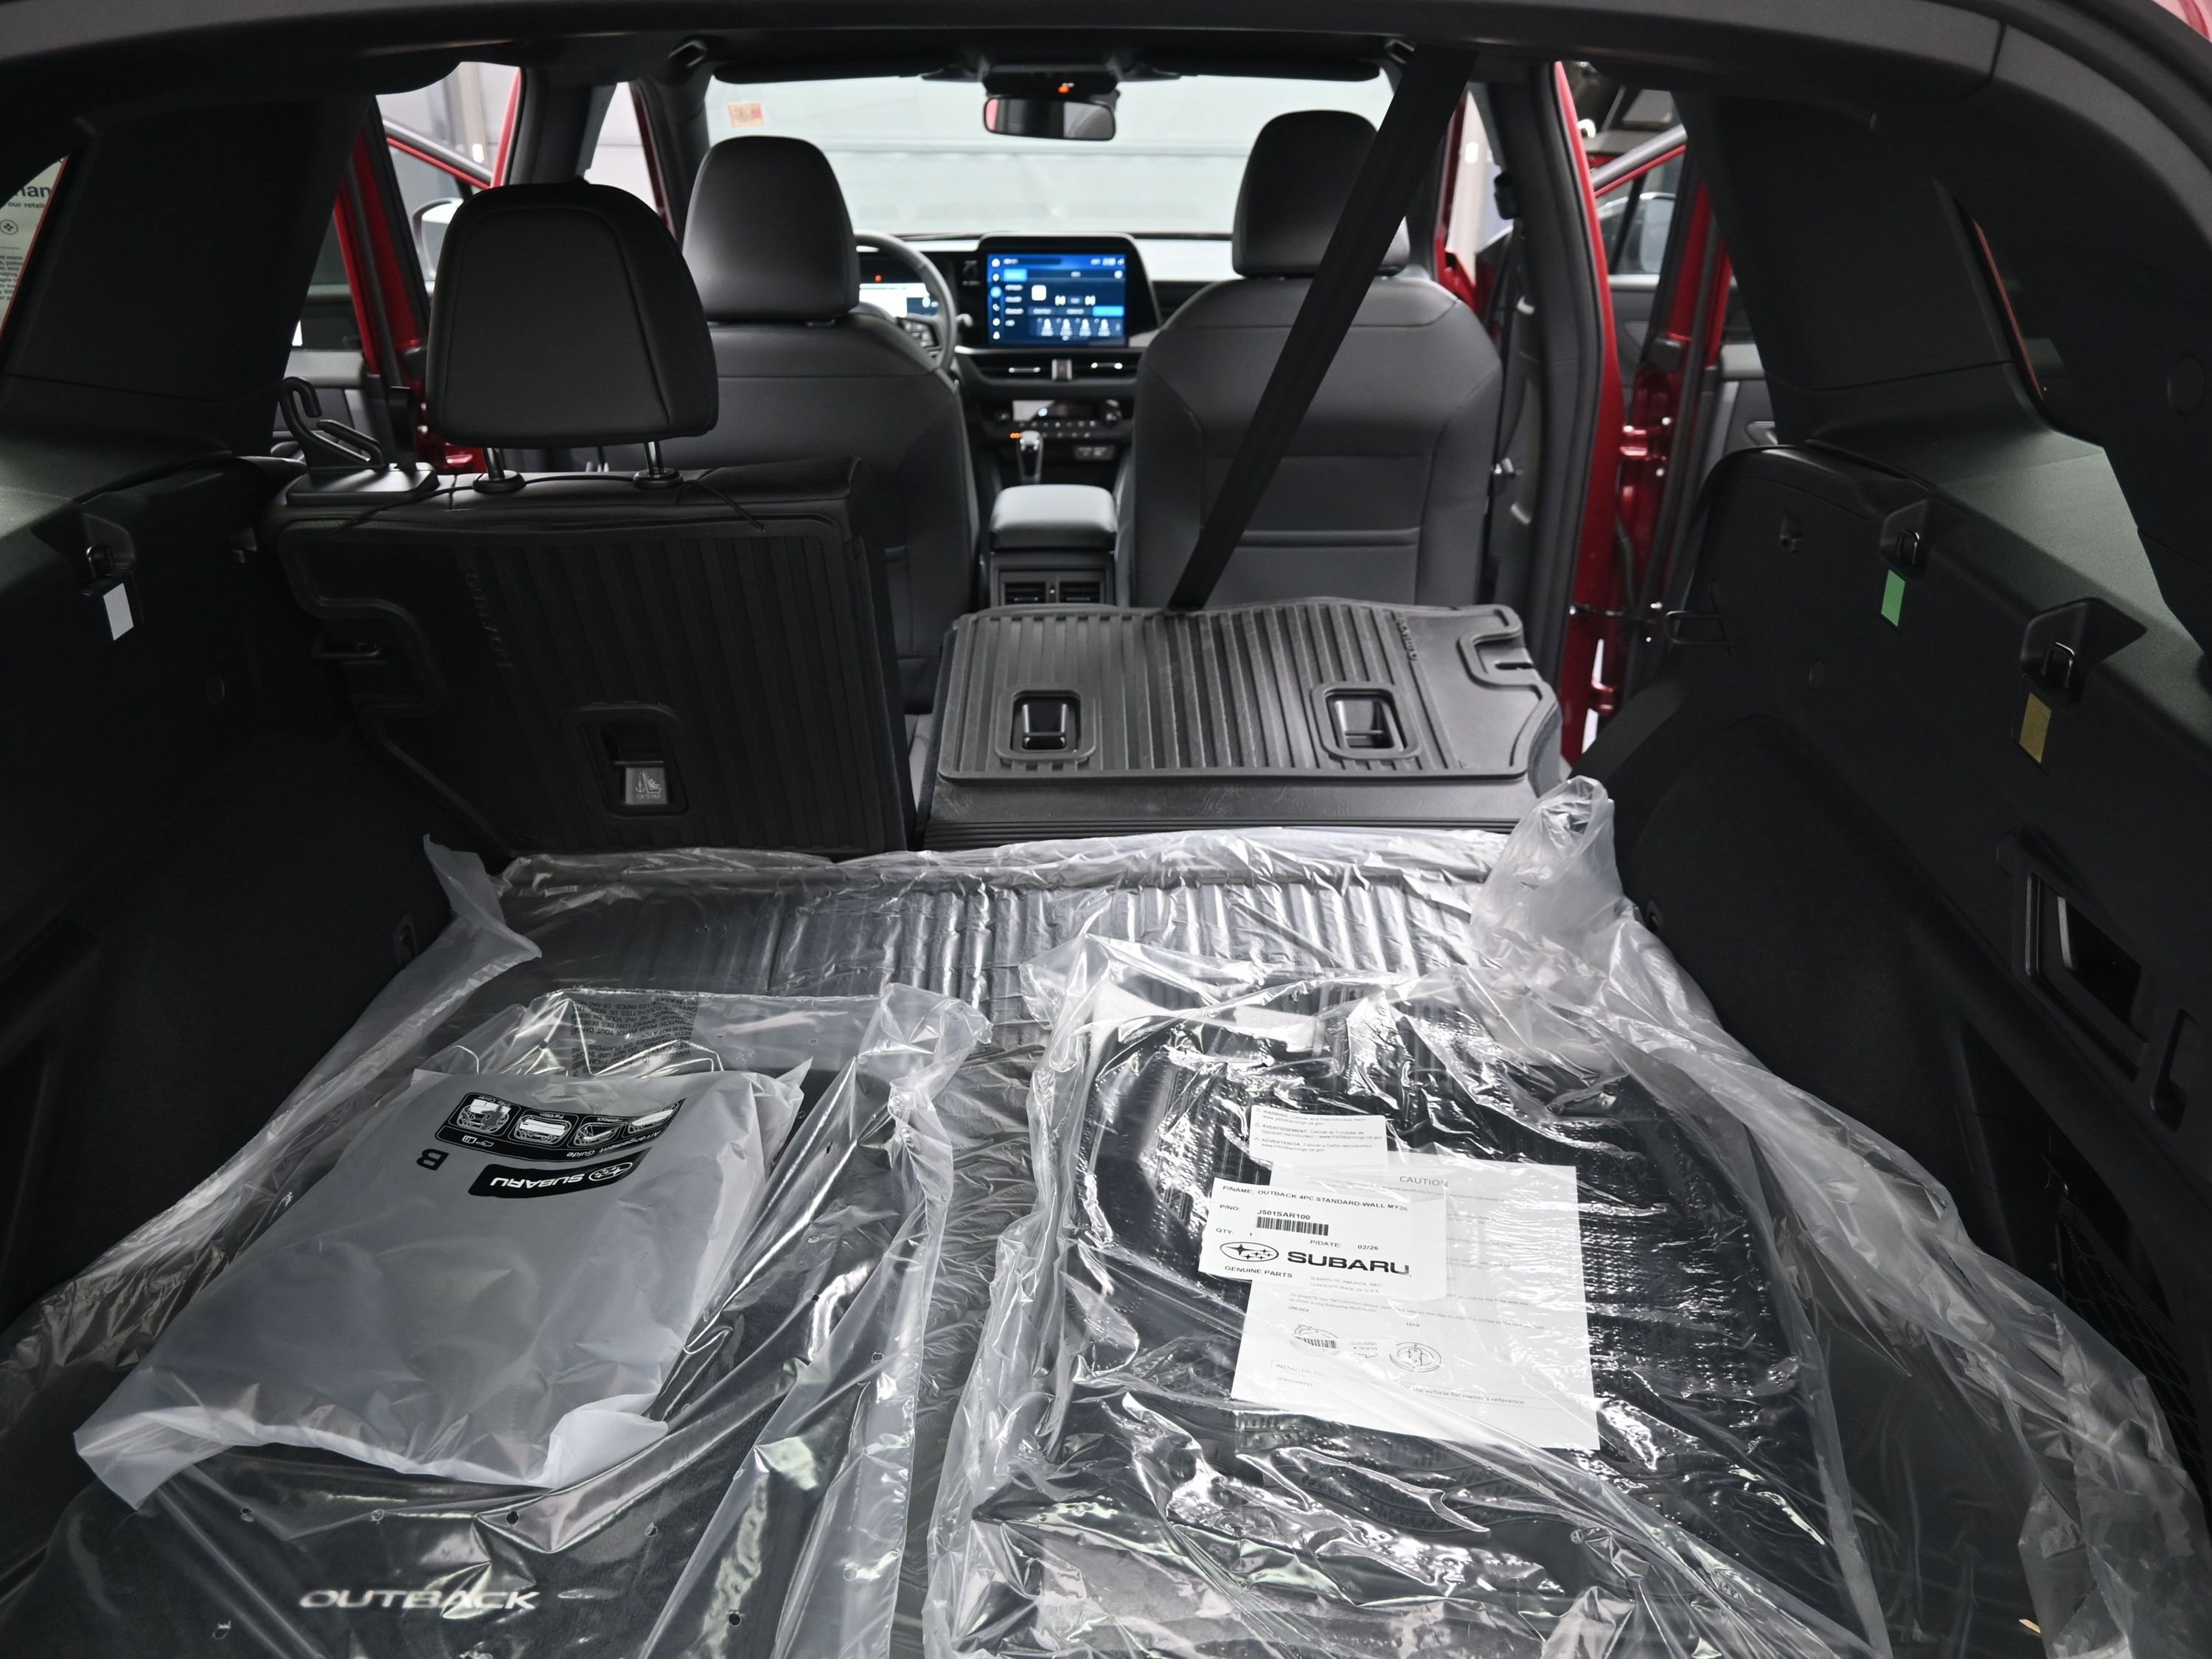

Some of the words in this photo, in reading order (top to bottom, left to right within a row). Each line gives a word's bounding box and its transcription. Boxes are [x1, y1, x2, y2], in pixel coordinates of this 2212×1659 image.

[599, 1130, 661, 1153] Arrangement
[417, 1149, 449, 1171] B
[490, 1174, 585, 1189] SUBARU
[1399, 1176, 1449, 1187] CAUTION
[1222, 1186, 1254, 1194] P/NAME:
[1257, 1190, 1298, 1199] OUTBACK
[1316, 1197, 1386, 1208] STANDARD-WALL
[1257, 1209, 1311, 1220] J501SAR100
[1310, 1239, 1343, 1248] P/DATE:
[1287, 1251, 1409, 1275] SUBARU
[1225, 1265, 1262, 1274] GENUINE
[1264, 1270, 1293, 1278] PARTS
[1425, 1388, 1450, 1397] vehicle
[299, 1590, 540, 1610] OUTBACK
